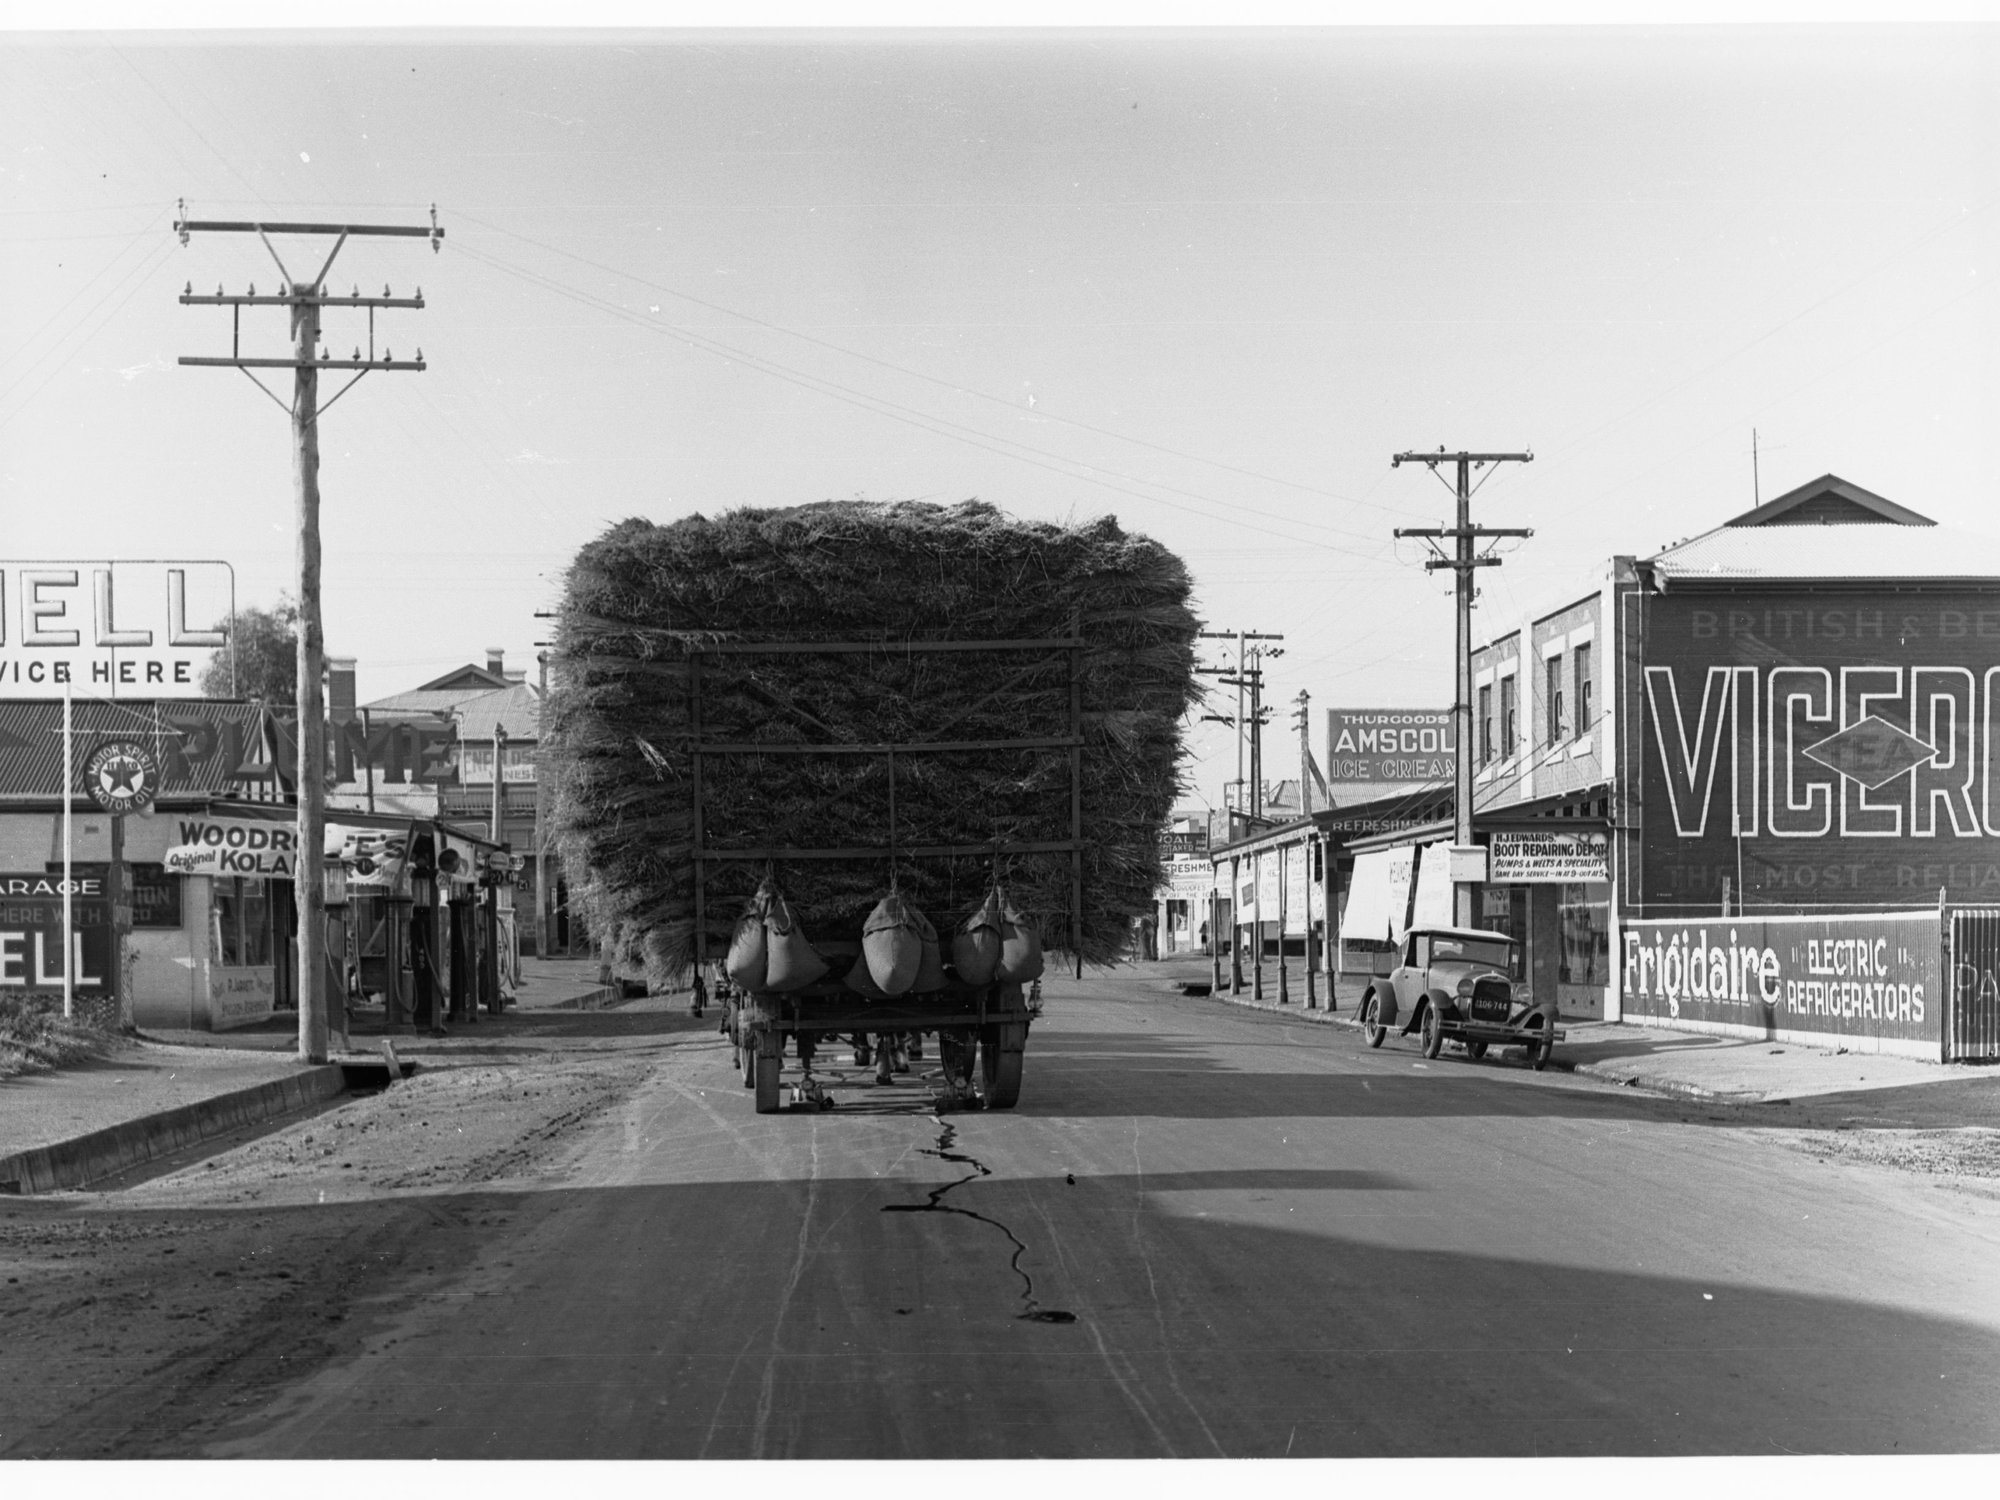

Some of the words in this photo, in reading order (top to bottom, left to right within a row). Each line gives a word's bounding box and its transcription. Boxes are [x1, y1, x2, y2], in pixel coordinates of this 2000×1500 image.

[0, 570, 226, 647] ELL
[1692, 610, 1883, 638] BRITISH
[93, 661, 191, 683] HERE
[1334, 728, 1456, 753] AMSCOL
[1644, 666, 2000, 837] VICER
[88, 745, 120, 776] MOTOR
[125, 744, 156, 774] SPIRIT
[1332, 760, 1370, 778] ICE
[91, 785, 132, 810] MOTOR
[135, 785, 154, 806] OIL
[169, 849, 216, 871] Original
[1494, 843, 1520, 857] BOOT
[1522, 843, 1574, 857] REPAIRING
[1576, 843, 1606, 857] DEPOT
[1495, 859, 1524, 868] PUMPS
[1525, 860, 1531, 868] &
[1532, 860, 1555, 868] WELTS
[1556, 860, 1562, 868] A
[1564, 859, 1603, 868] SPECIALITY
[1495, 870, 1510, 878] SAME
[1512, 870, 1525, 878] DAY
[1526, 870, 1549, 878] SERVICE
[1765, 865, 1864, 889] MOST
[53, 907, 101, 923] WTH
[1623, 928, 1781, 1017] Frigidaire
[1787, 980, 1925, 1022] REFRIGERATORS
